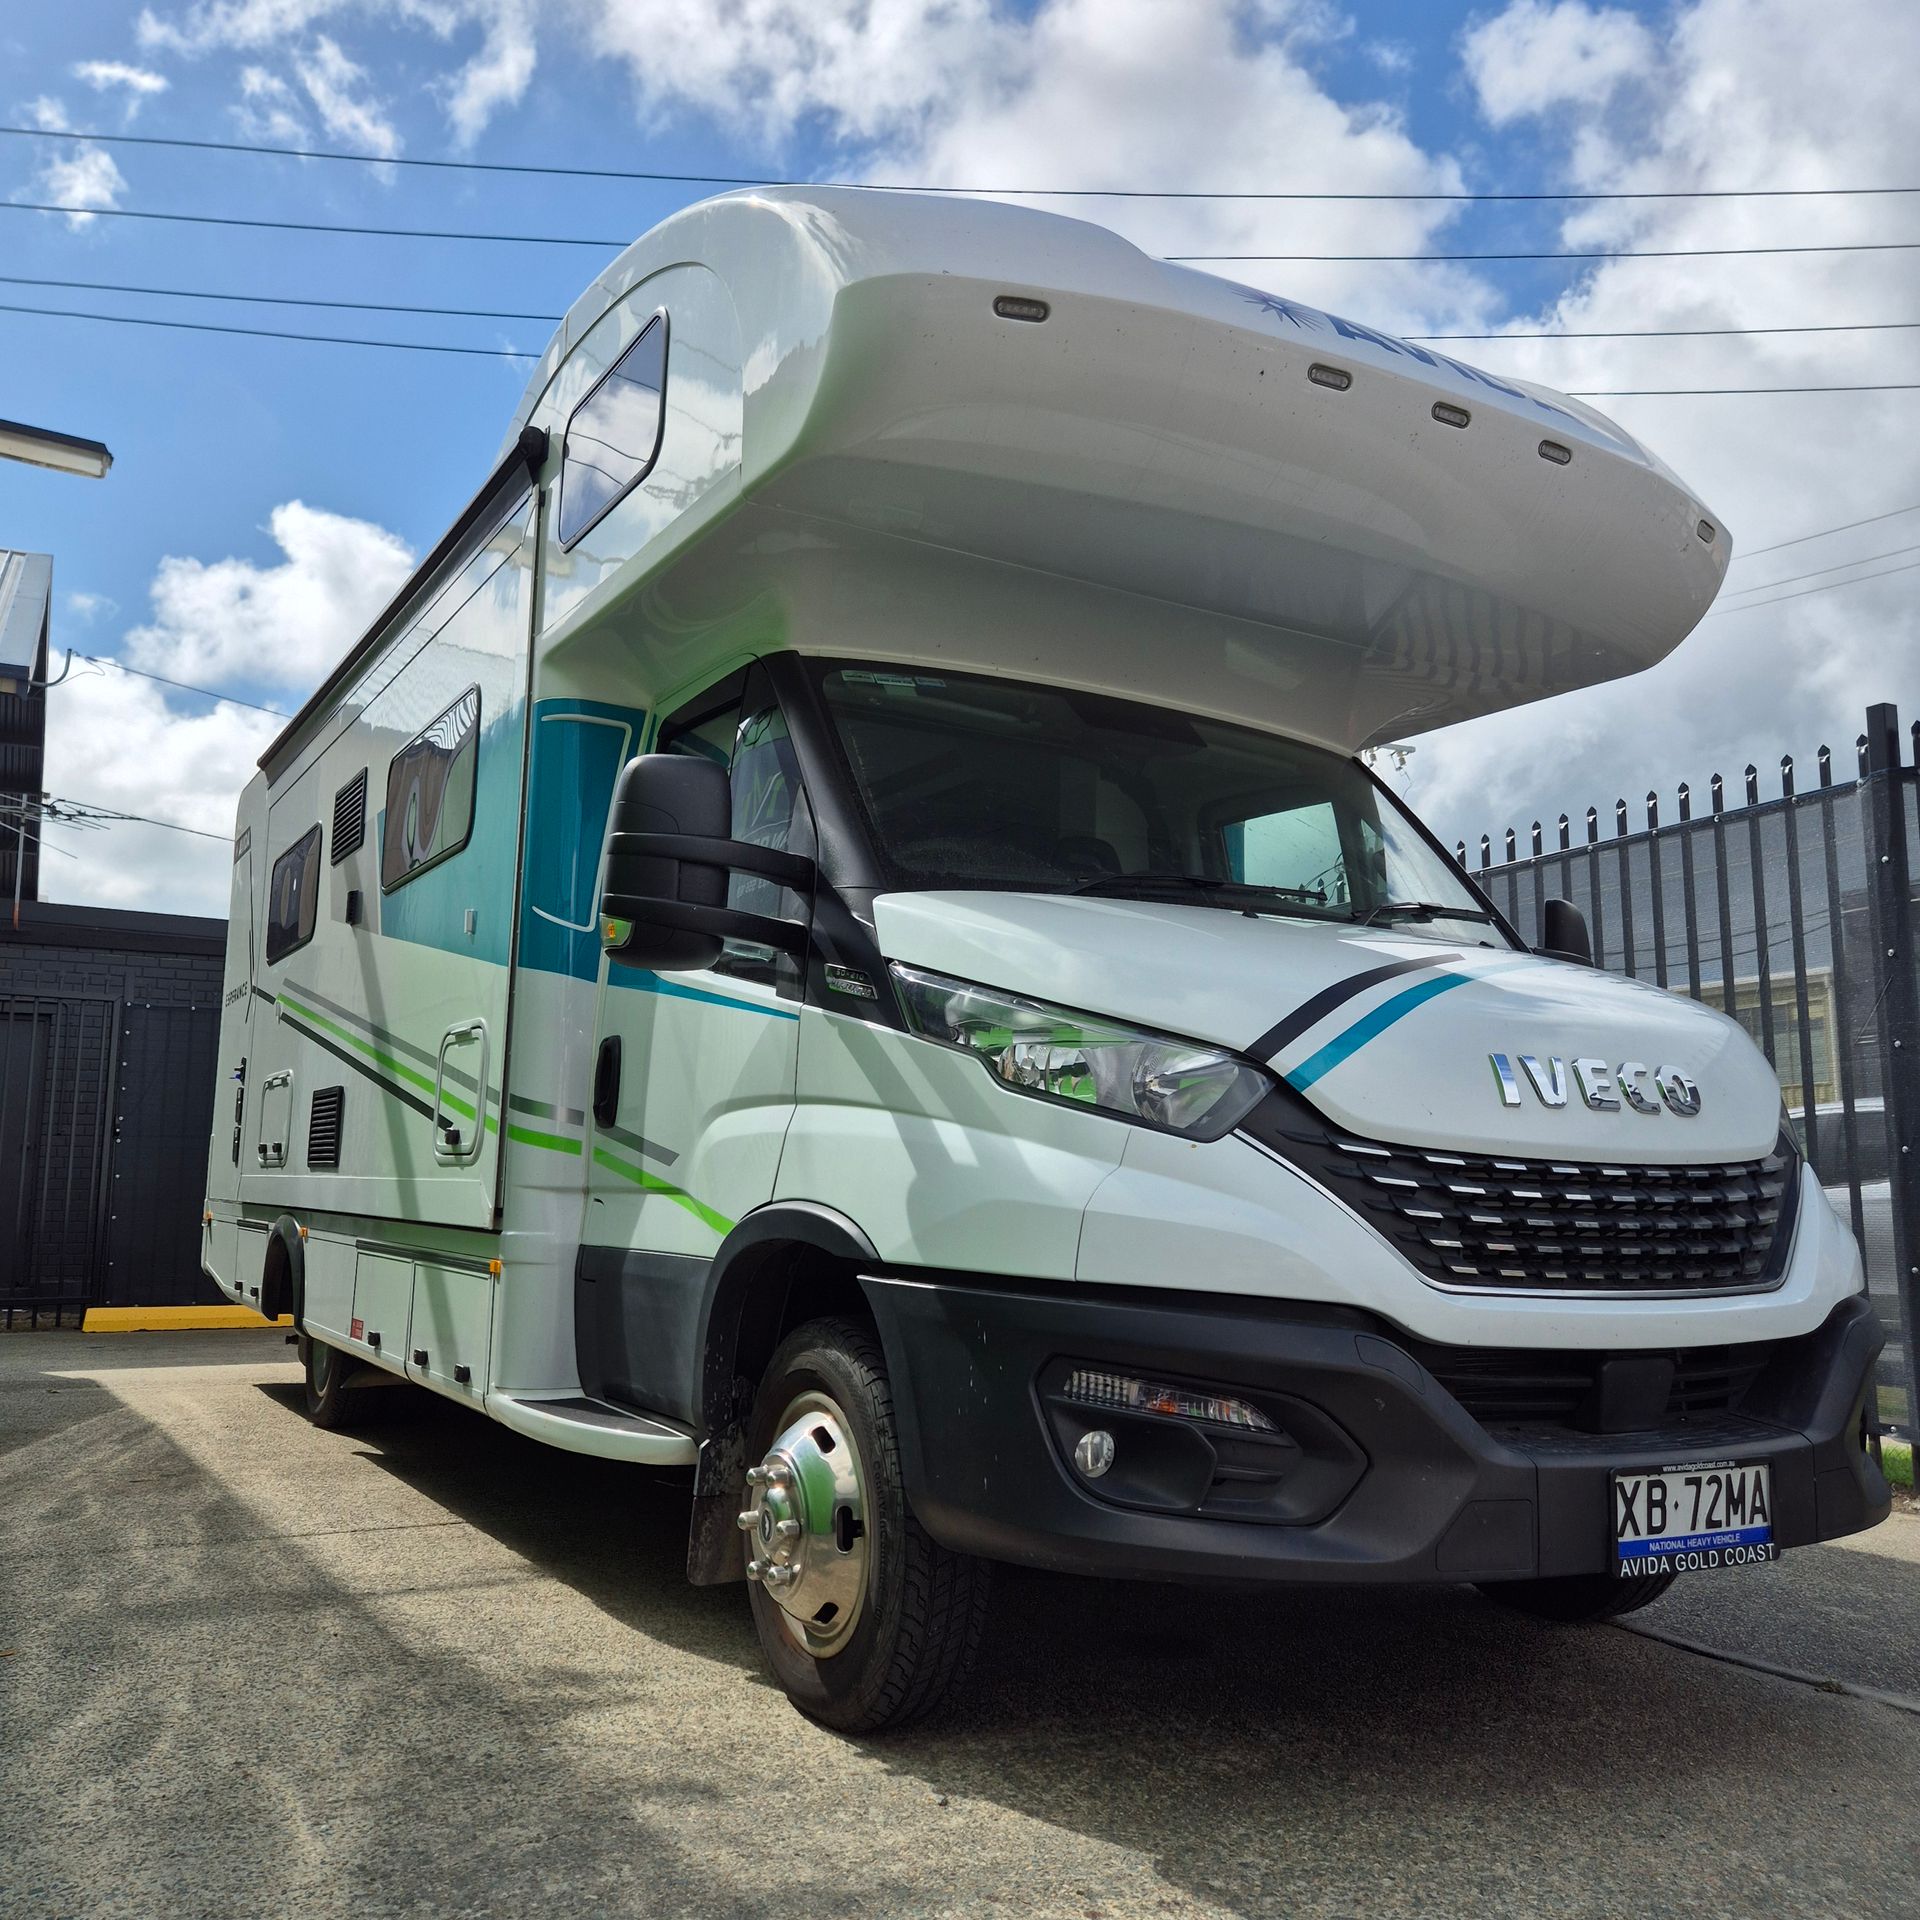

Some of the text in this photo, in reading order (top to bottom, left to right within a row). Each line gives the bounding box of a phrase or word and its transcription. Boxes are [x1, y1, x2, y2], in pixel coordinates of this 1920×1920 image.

[1488, 1052, 1702, 1118] IVECO
[1662, 1460, 1736, 1472] www.avidagoldcoast.com.au
[1649, 1533, 1741, 1552] NATIONAL HEAVY VEHICLE
[1620, 1543, 1775, 1578] AVIDA GOLD COAST
